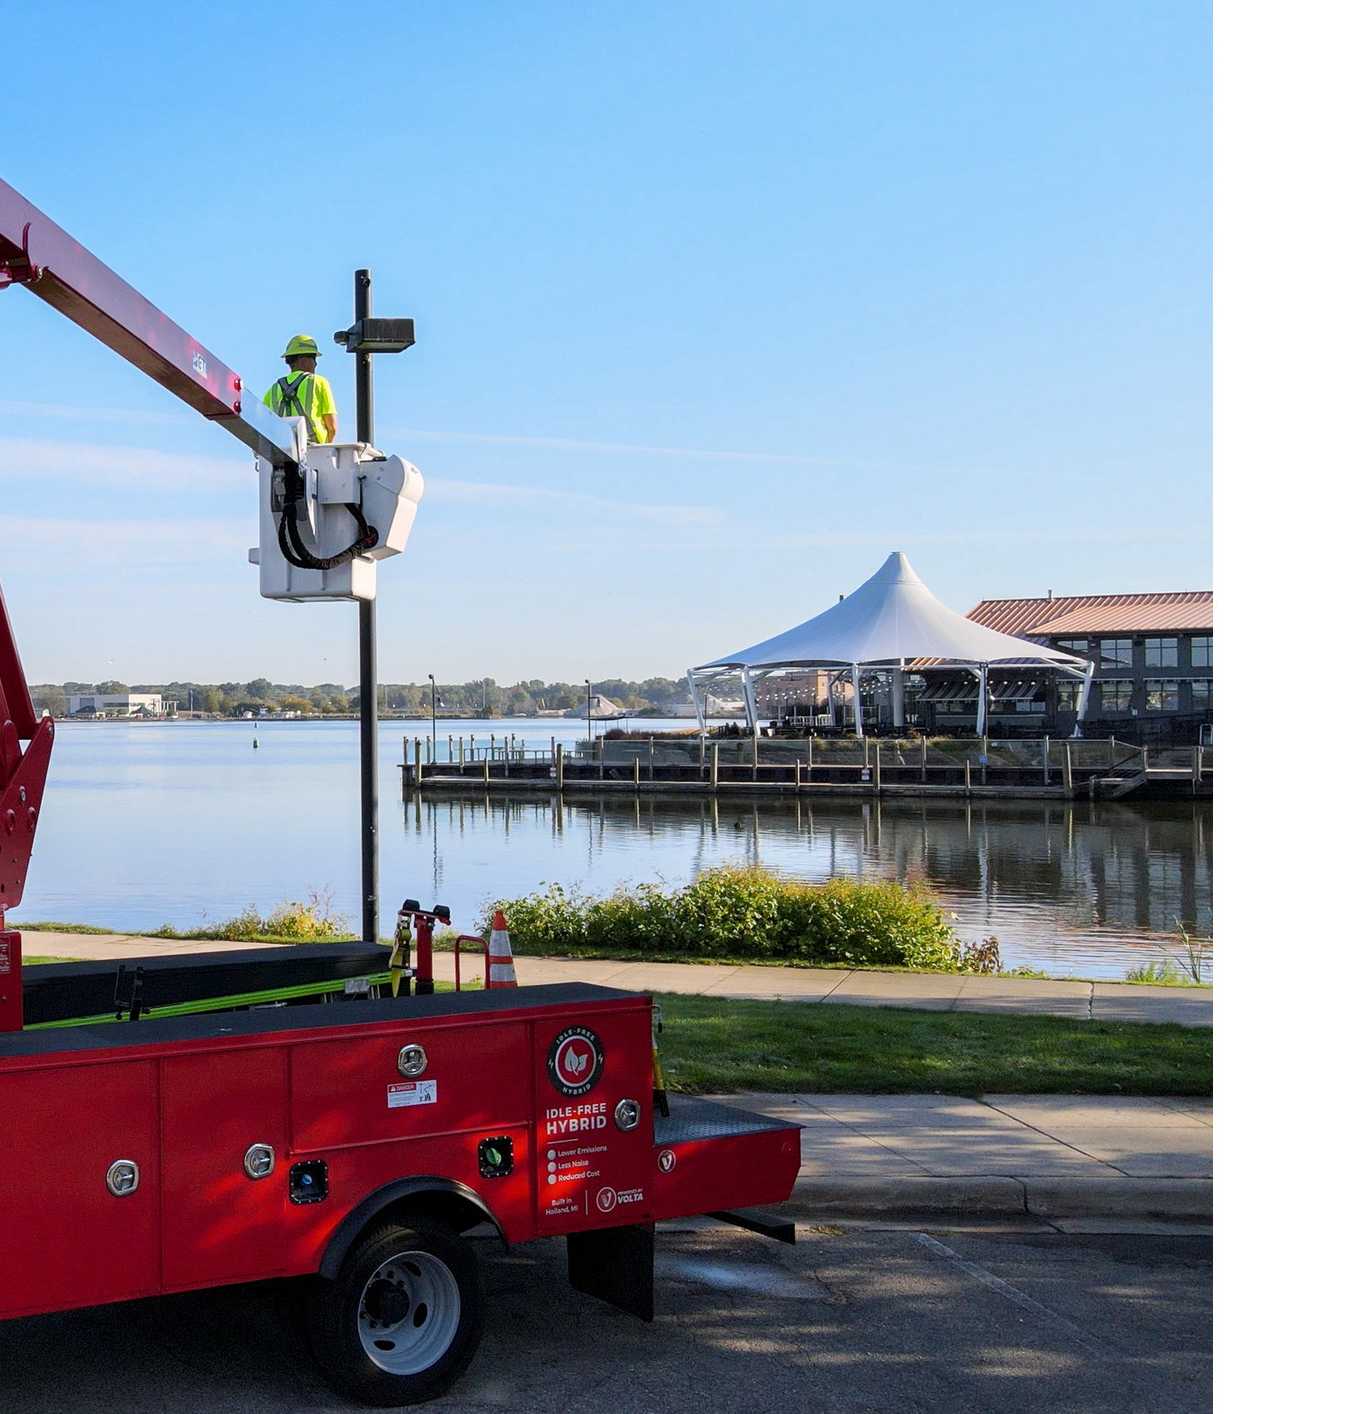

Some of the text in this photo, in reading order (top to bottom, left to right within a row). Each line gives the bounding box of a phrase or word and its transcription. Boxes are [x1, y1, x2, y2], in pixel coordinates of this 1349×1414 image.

[556, 1027, 595, 1044] IDLE-FREE
[562, 1083, 591, 1095] HYBRID
[546, 1102, 607, 1119] IDLE-FREE
[546, 1115, 607, 1135] HYBRID
[557, 1145, 608, 1158] Lower Emissions
[558, 1159, 589, 1170] Less Noise
[558, 1170, 600, 1182] Reduced Cost
[551, 1198, 565, 1206] Built
[617, 1193, 643, 1204] VOLTA
[545, 1207, 570, 1216] Holland,
